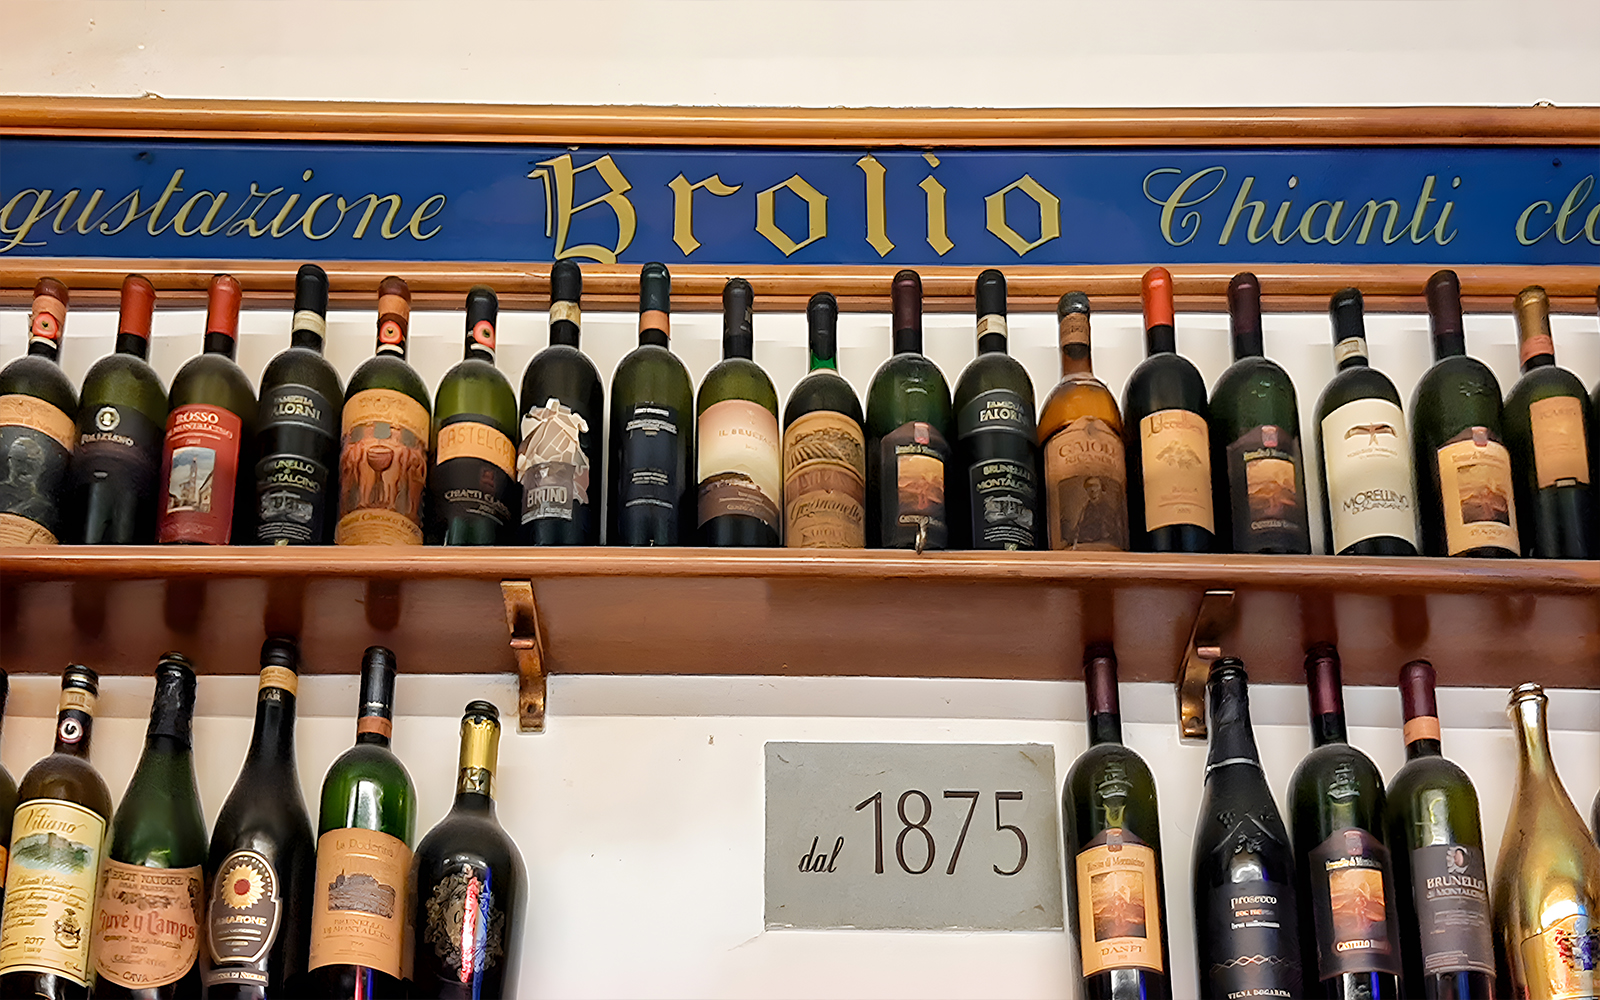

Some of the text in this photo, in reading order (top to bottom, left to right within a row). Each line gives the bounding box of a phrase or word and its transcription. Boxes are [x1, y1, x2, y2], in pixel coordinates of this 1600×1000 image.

[0, 167, 447, 252] gustazione
[527, 151, 1061, 264] Brolio
[1142, 165, 1457, 247] Chianti
[175, 410, 220, 426] ROSSO
[527, 486, 568, 508] BRUNO
[798, 789, 1029, 877] dal 1875
[1426, 876, 1486, 893] BRUNELLO
[128, 914, 144, 935] y
[147, 909, 196, 942] Camps
[122, 970, 150, 983] CAVA
